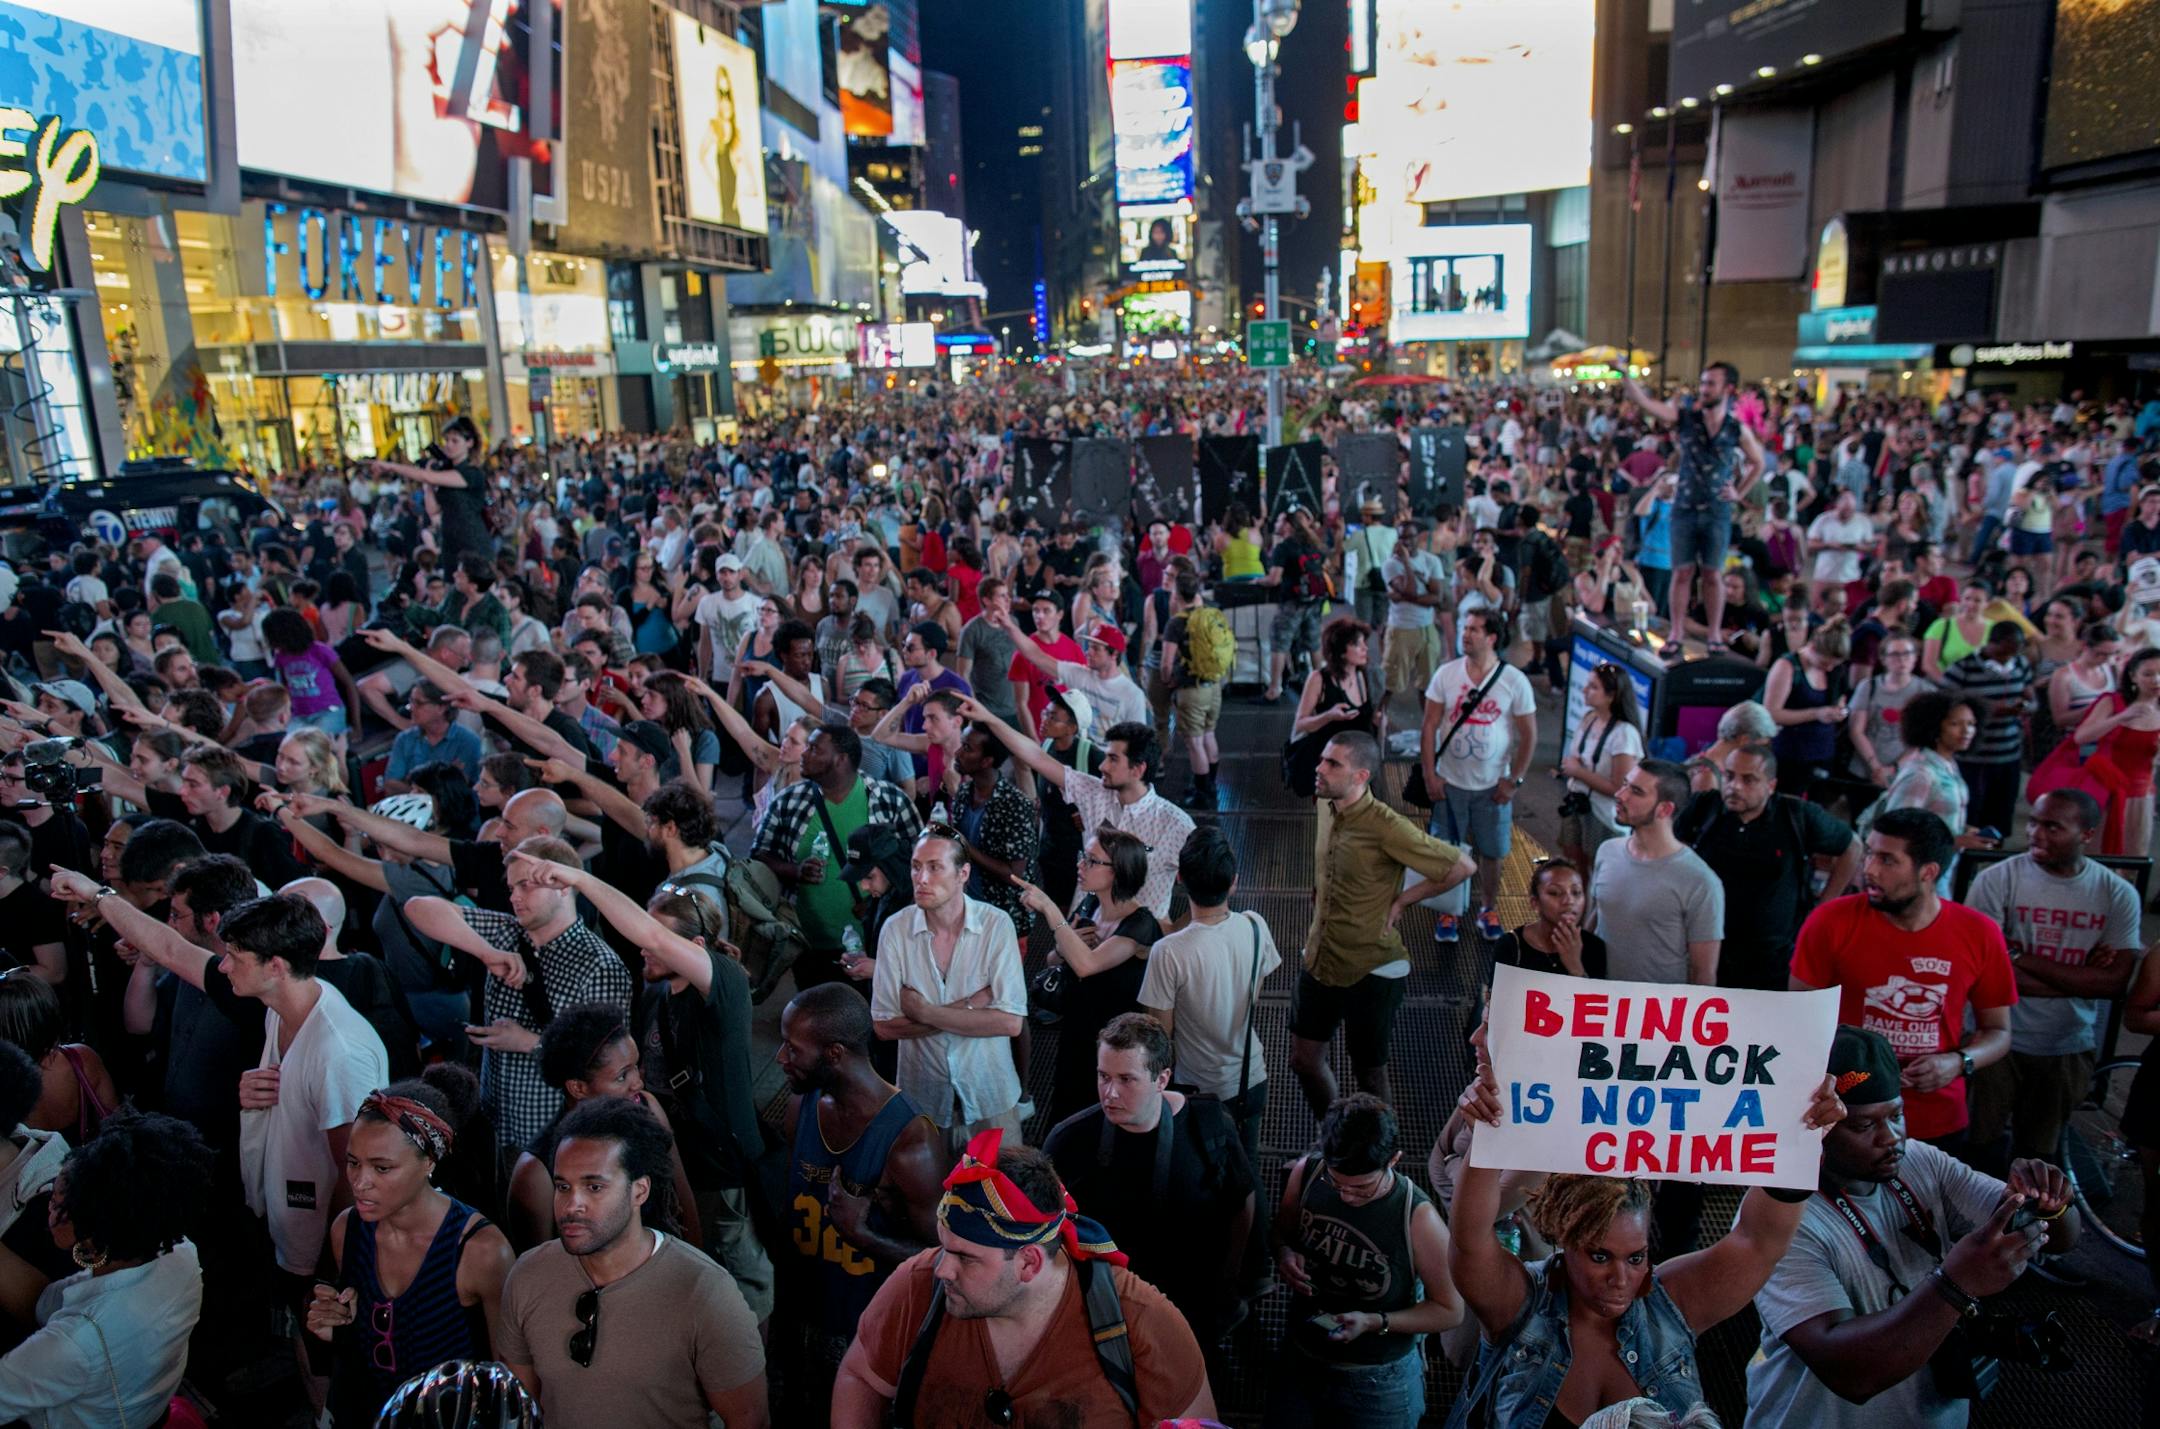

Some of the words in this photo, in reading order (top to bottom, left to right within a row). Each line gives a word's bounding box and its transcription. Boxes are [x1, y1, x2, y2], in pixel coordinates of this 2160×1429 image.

[264, 202, 480, 308] FOREVER
[1883, 246, 1997, 274] MARQUIS
[1976, 342, 2042, 365] sunglass
[2044, 340, 2073, 359] hut
[2016, 906, 2106, 930] TEACH
[2036, 928, 2063, 943] FOR
[1913, 959, 1949, 973] SOS
[1524, 990, 1729, 1046] BEING
[1863, 1014, 1904, 1031] SAVE
[1908, 1021, 1939, 1033] OUR
[1578, 1042, 1781, 1085] BLACK
[1511, 1082, 1555, 1124] IS
[1581, 1085, 1701, 1130] NOT
[1723, 1089, 1765, 1128] A
[1585, 1130, 1778, 1174] CRIME
[1325, 1222, 1349, 1239] THE
[1836, 1197, 1867, 1236] Canon
[1301, 1208, 1391, 1274] BEATLES
